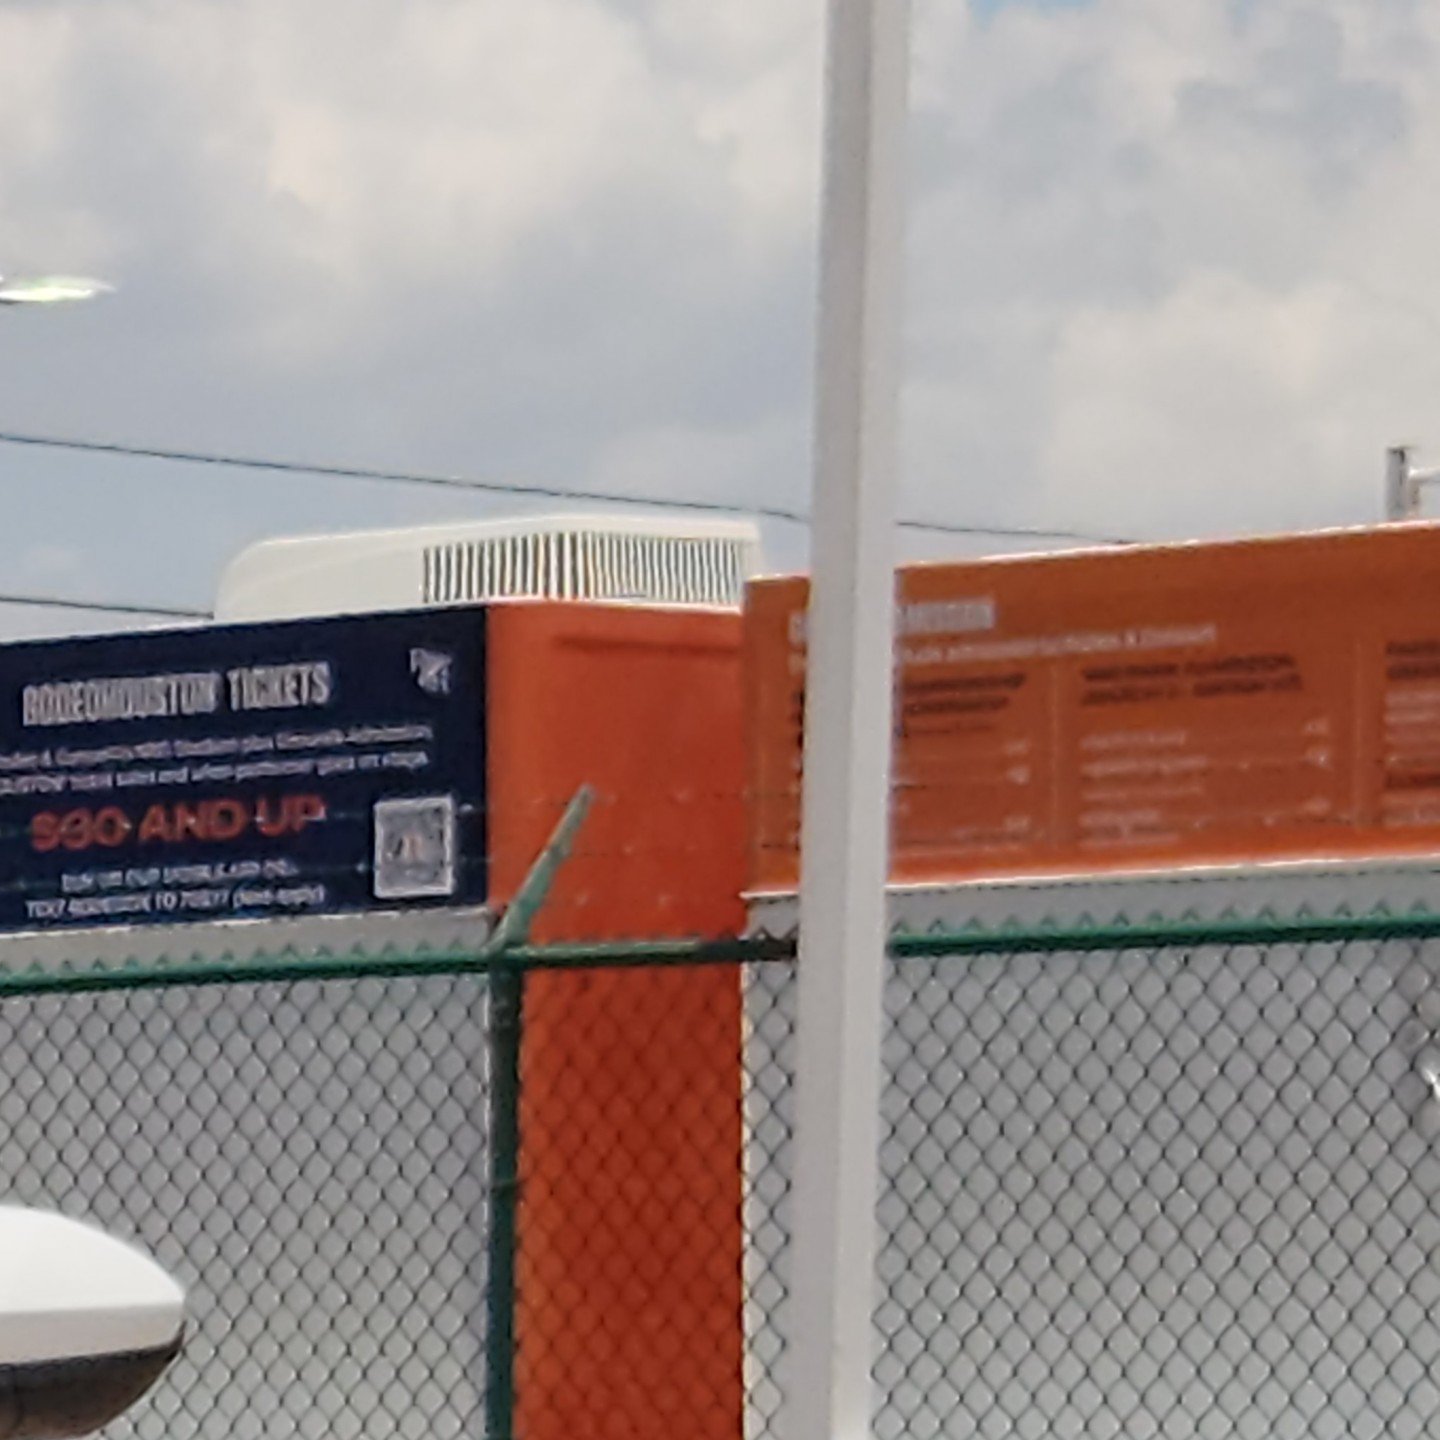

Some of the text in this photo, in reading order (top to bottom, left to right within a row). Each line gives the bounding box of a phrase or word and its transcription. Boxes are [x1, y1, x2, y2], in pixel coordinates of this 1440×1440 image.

[225, 660, 332, 711] TICKETS
[137, 798, 249, 842] AND
[253, 793, 329, 836] UP
